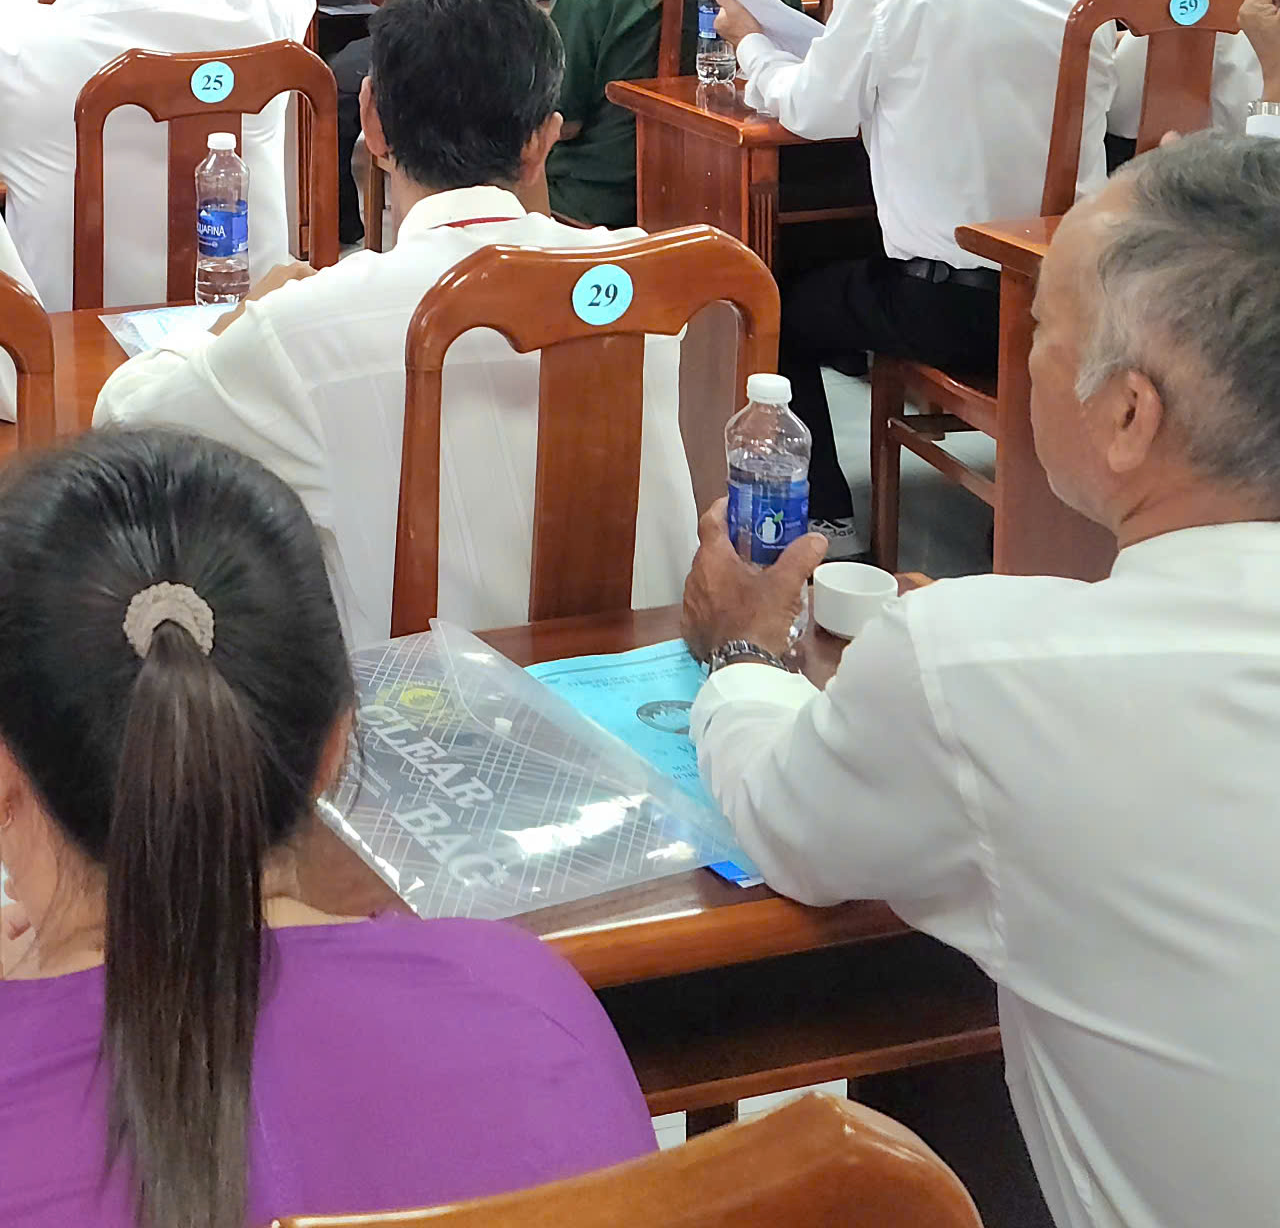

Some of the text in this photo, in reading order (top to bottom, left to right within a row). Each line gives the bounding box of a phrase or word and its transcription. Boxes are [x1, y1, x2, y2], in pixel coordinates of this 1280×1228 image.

[202, 75, 223, 91] 25
[587, 283, 619, 308] 29
[359, 704, 495, 808] CLEAR
[392, 802, 509, 887] BAG
